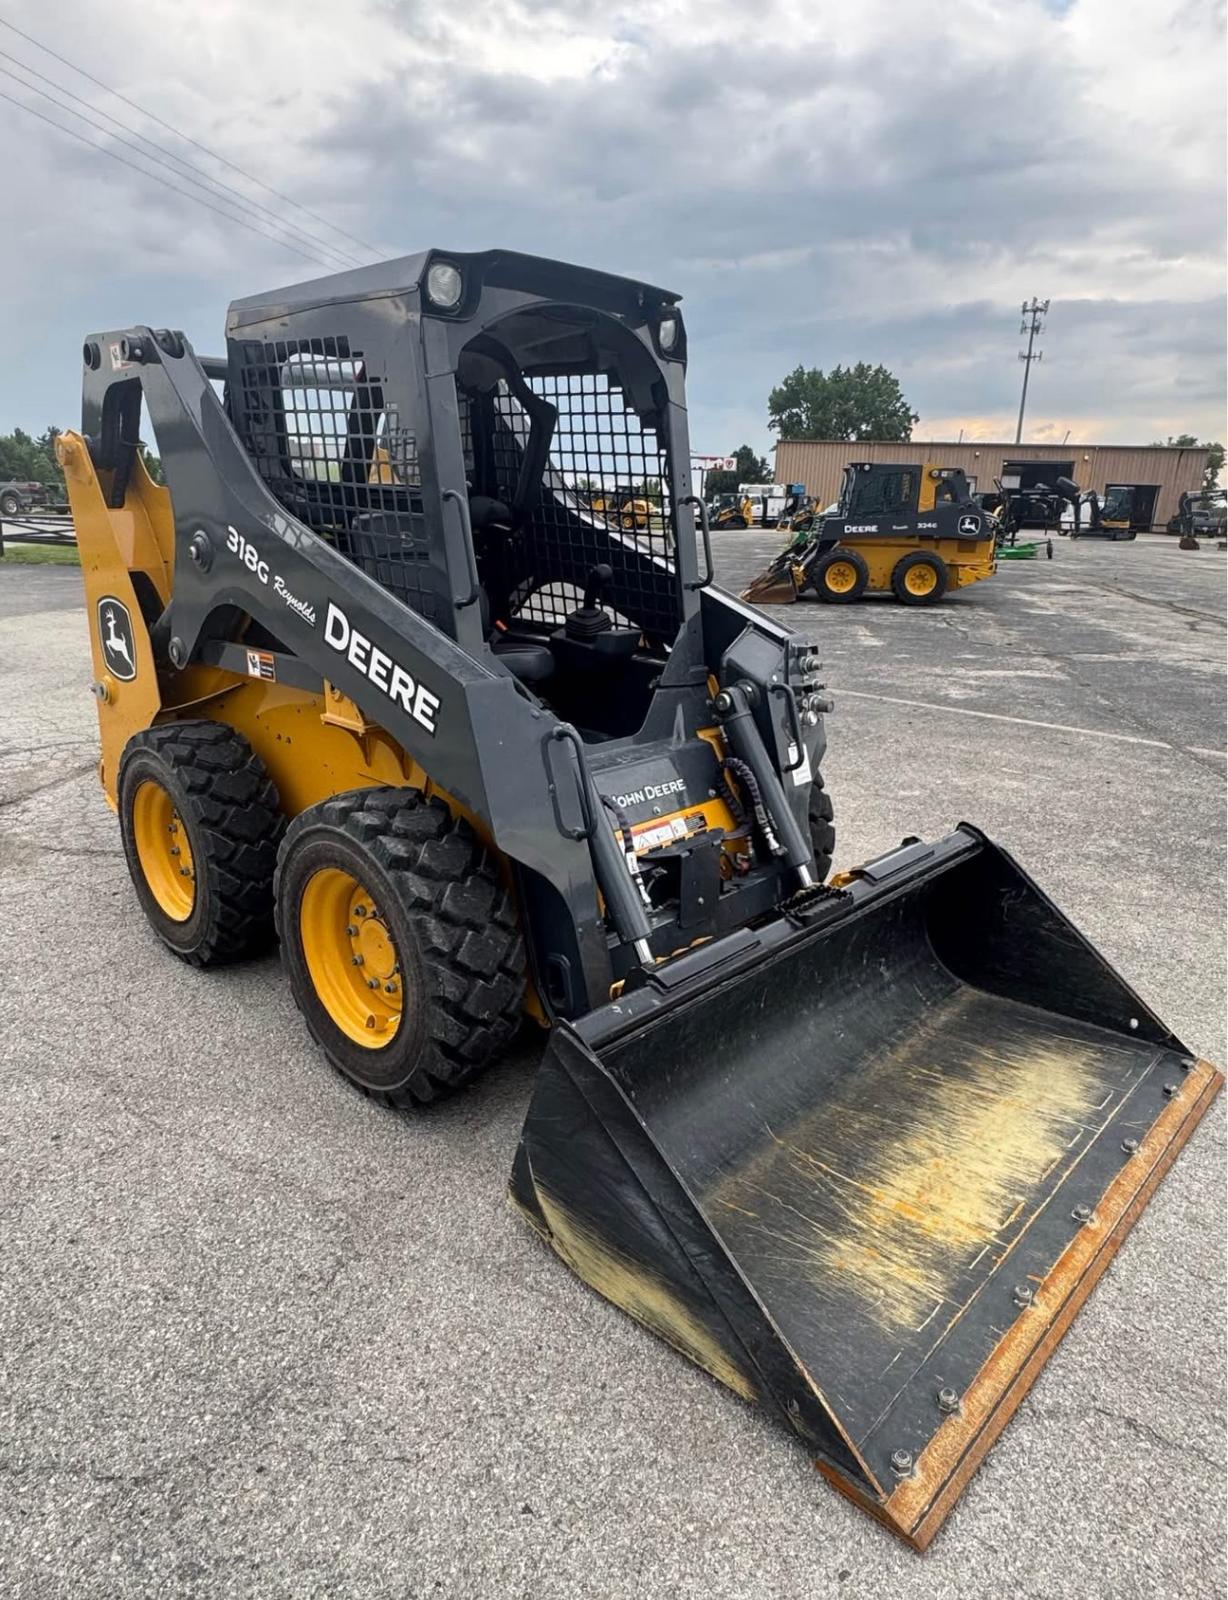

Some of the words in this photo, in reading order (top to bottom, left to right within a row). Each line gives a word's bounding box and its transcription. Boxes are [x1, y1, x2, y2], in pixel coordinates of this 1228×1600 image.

[844, 524, 878, 534] DEERE
[226, 525, 270, 585] 318G
[273, 575, 316, 623] Reynolds
[324, 602, 440, 733] DEERE
[612, 790, 646, 808] OHN
[644, 779, 687, 800] DEERE
